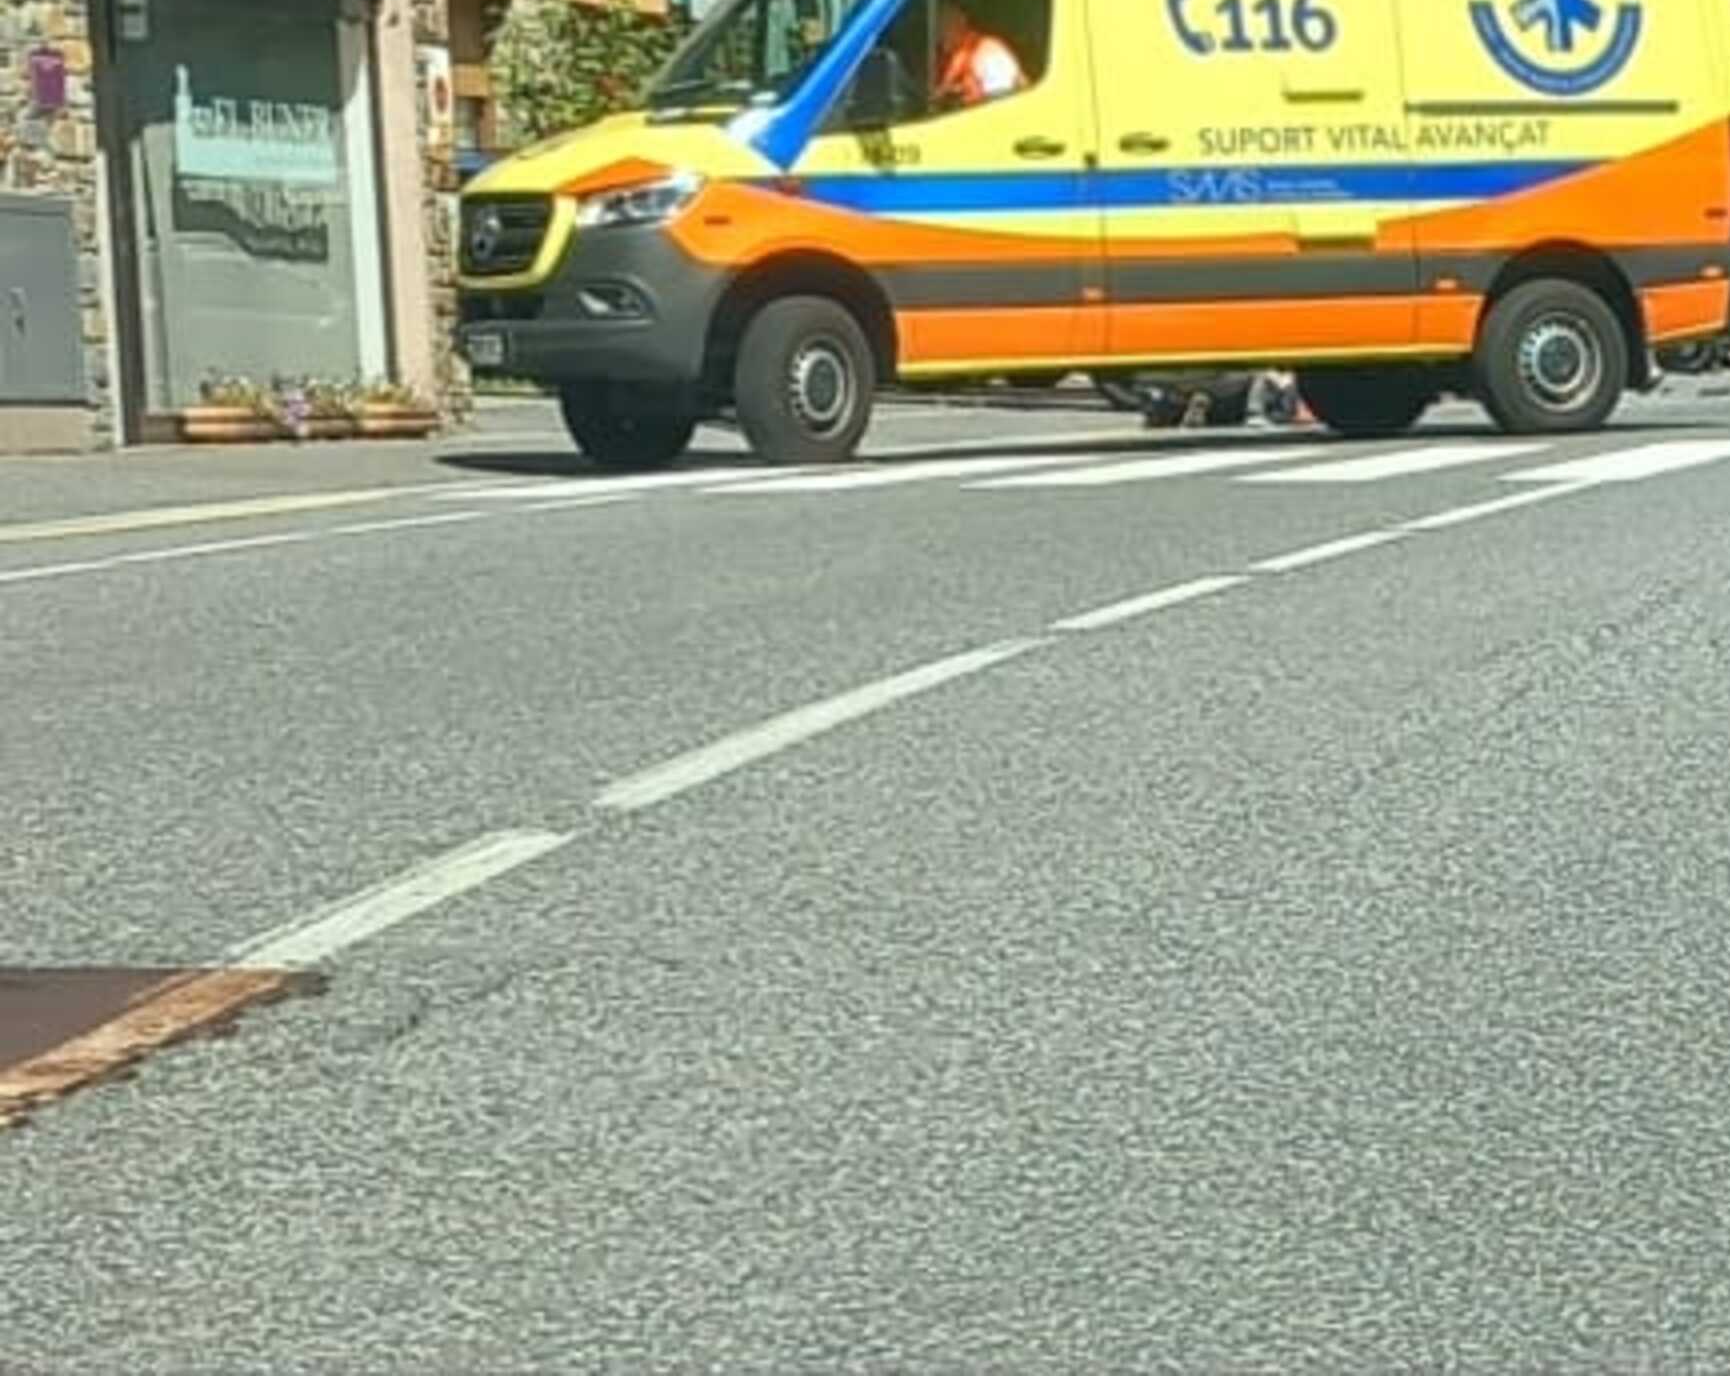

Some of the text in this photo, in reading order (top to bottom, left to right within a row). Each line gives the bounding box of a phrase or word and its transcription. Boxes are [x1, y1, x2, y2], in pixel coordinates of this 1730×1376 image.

[1198, 119, 1551, 156] SUPORT VITAL AVANÇAT
